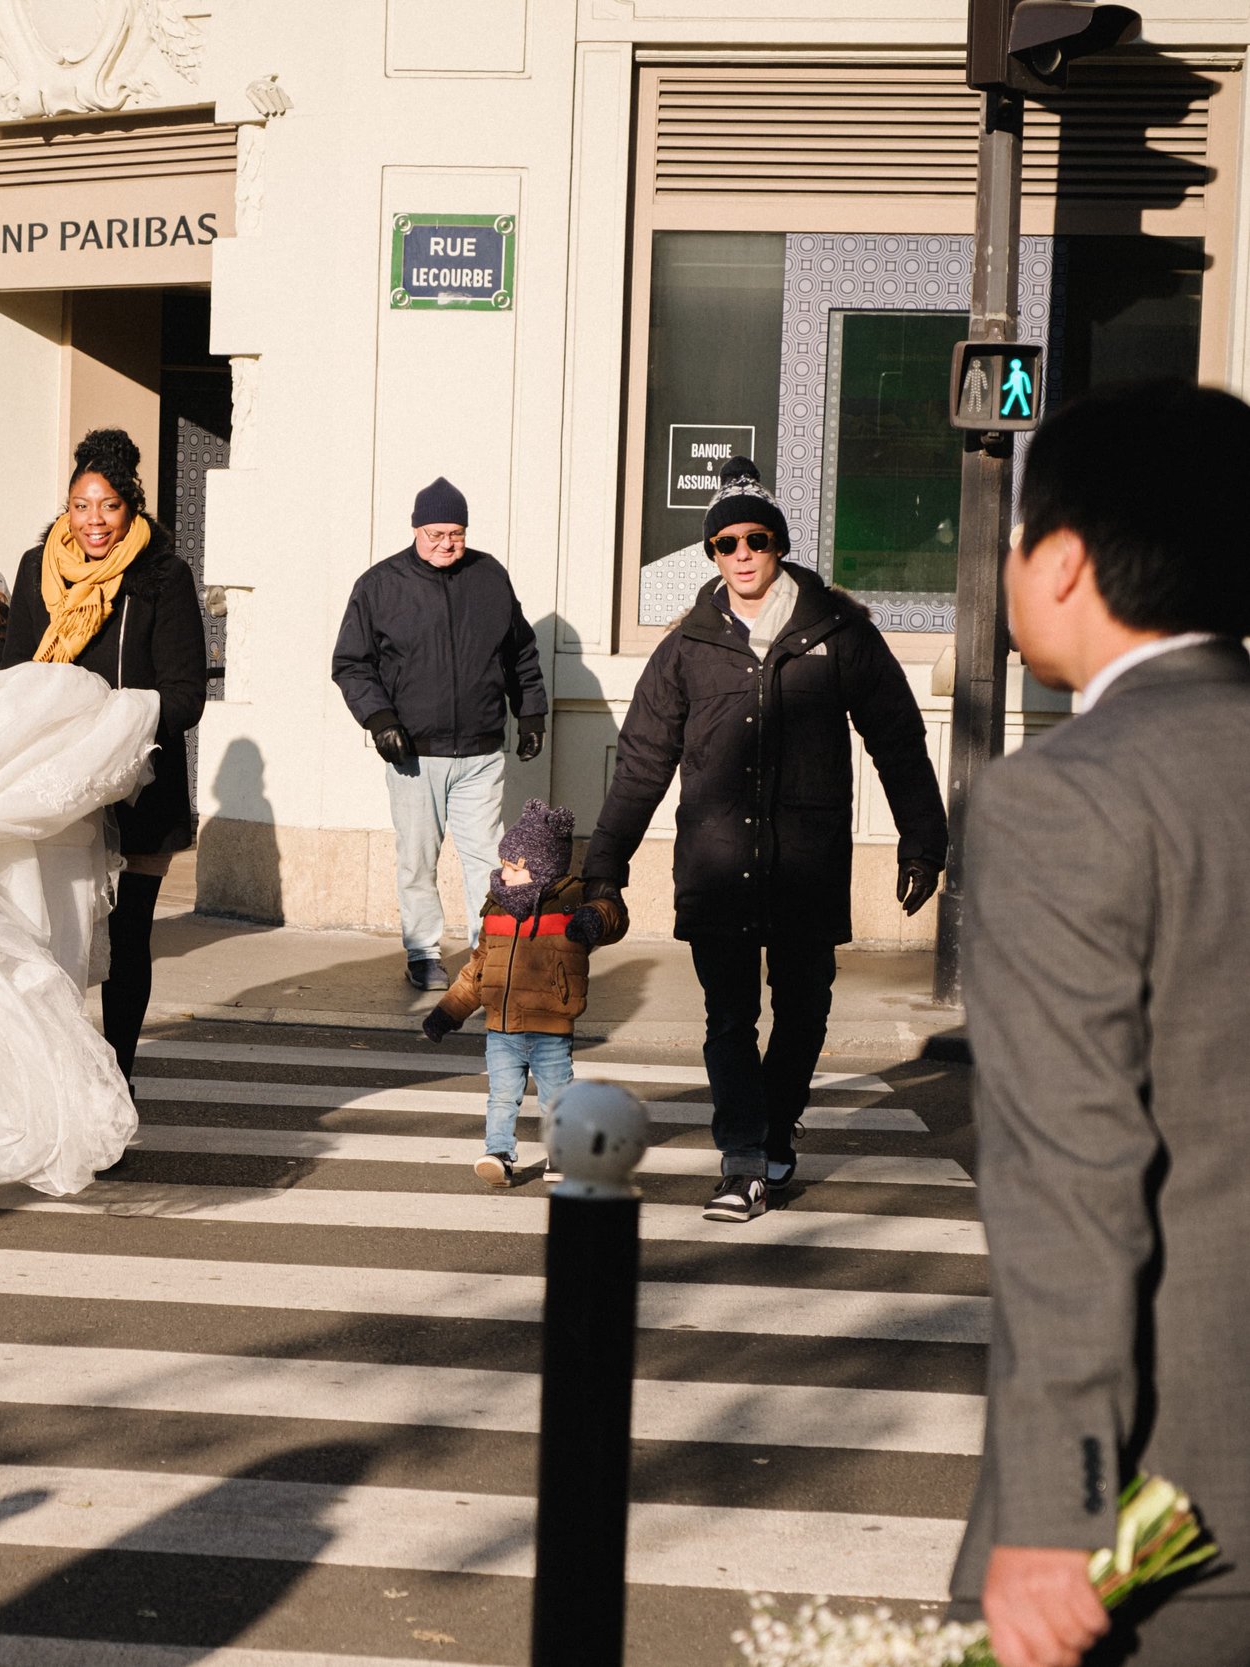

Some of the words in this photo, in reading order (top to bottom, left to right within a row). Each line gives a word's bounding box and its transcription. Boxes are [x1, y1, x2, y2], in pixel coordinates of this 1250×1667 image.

[60, 213, 218, 251] PARIBAS
[430, 237, 477, 257] RUE
[412, 267, 493, 288] LECOURBE
[691, 443, 732, 460] BANQUE
[706, 461, 713, 472] &
